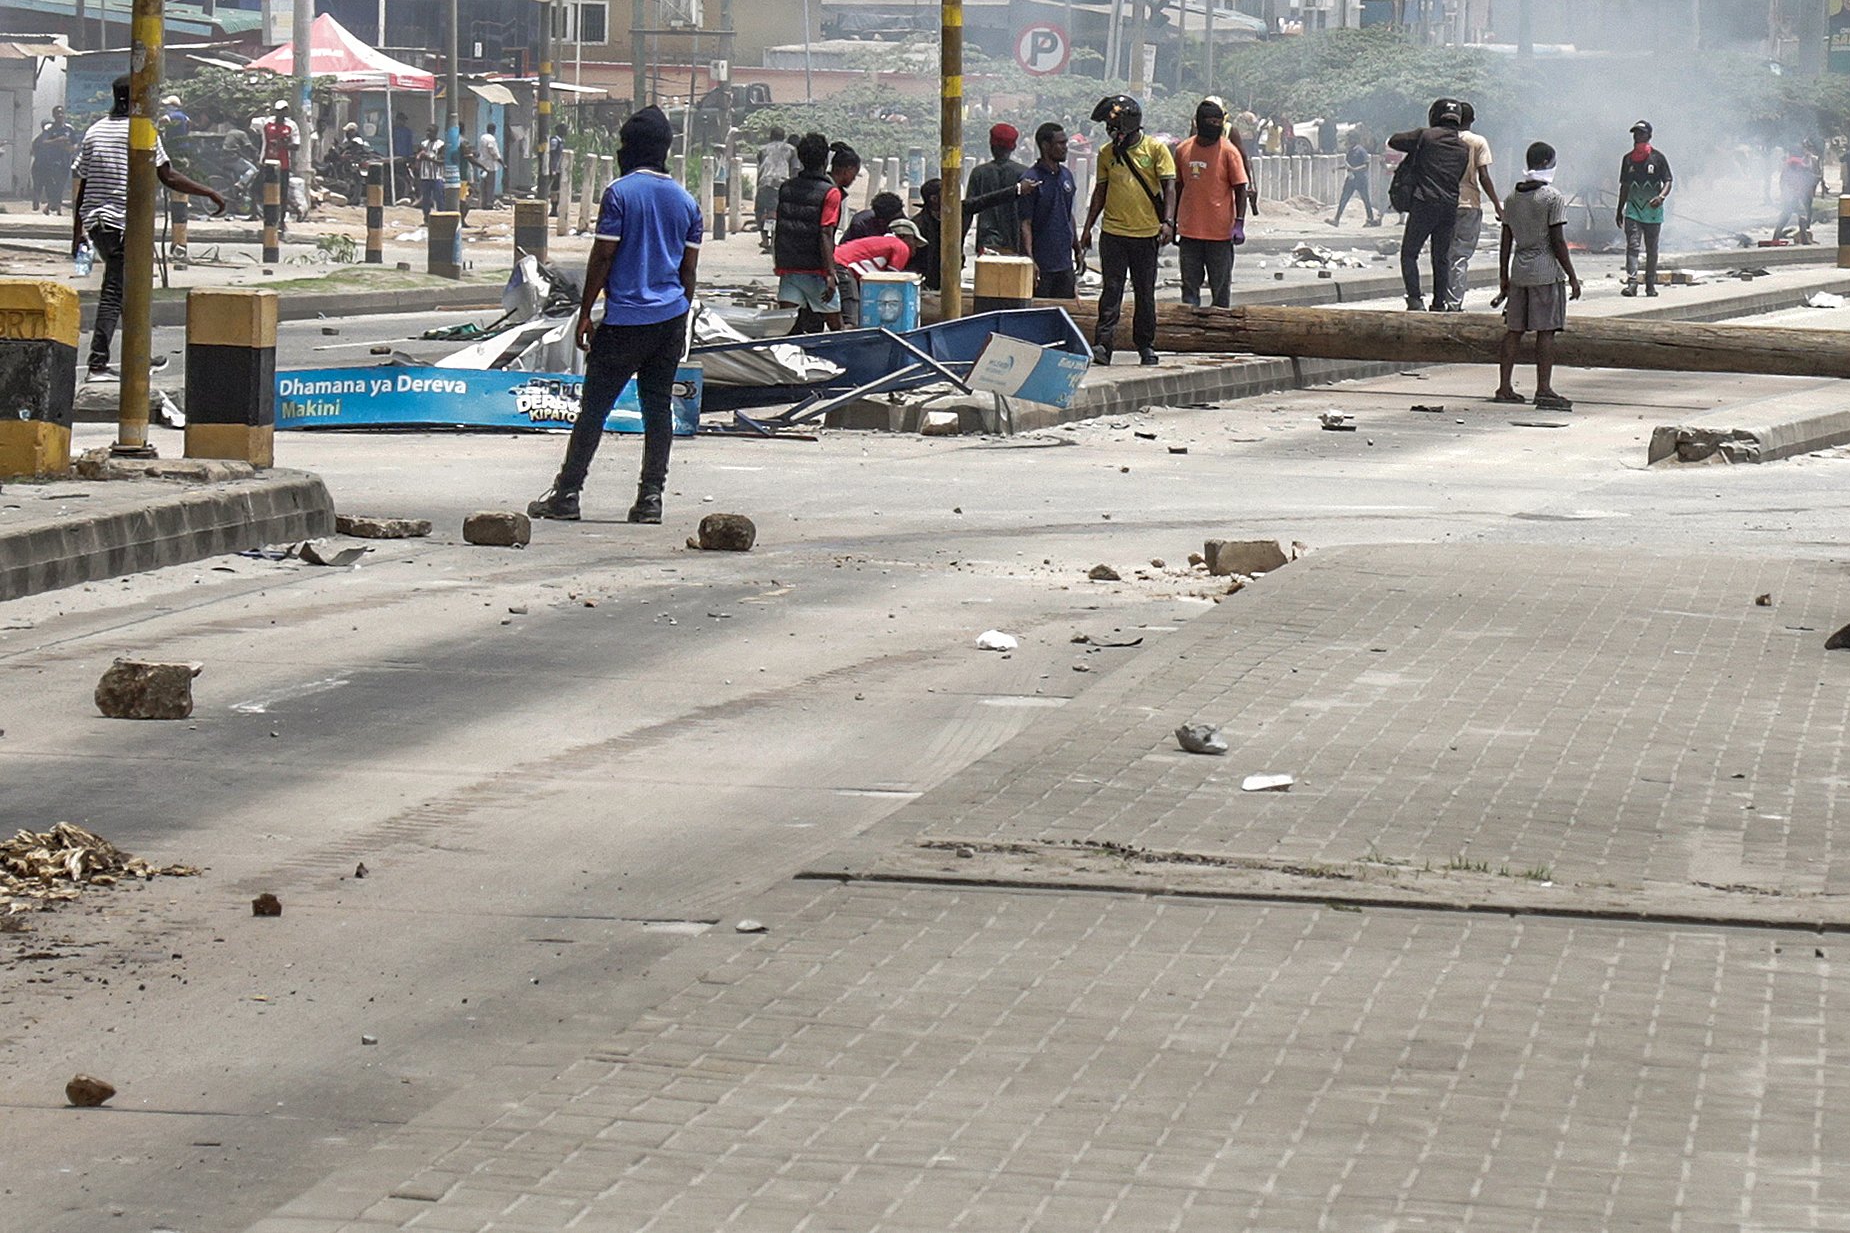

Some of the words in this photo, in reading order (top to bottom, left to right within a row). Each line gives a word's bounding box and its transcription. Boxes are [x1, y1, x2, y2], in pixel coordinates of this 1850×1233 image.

[1030, 31, 1059, 66] P
[279, 378, 366, 396] Dhamana
[370, 379, 393, 397] ya
[397, 375, 467, 394] Dereva
[281, 399, 342, 418] Makini
[528, 408, 578, 423] KIPATO
